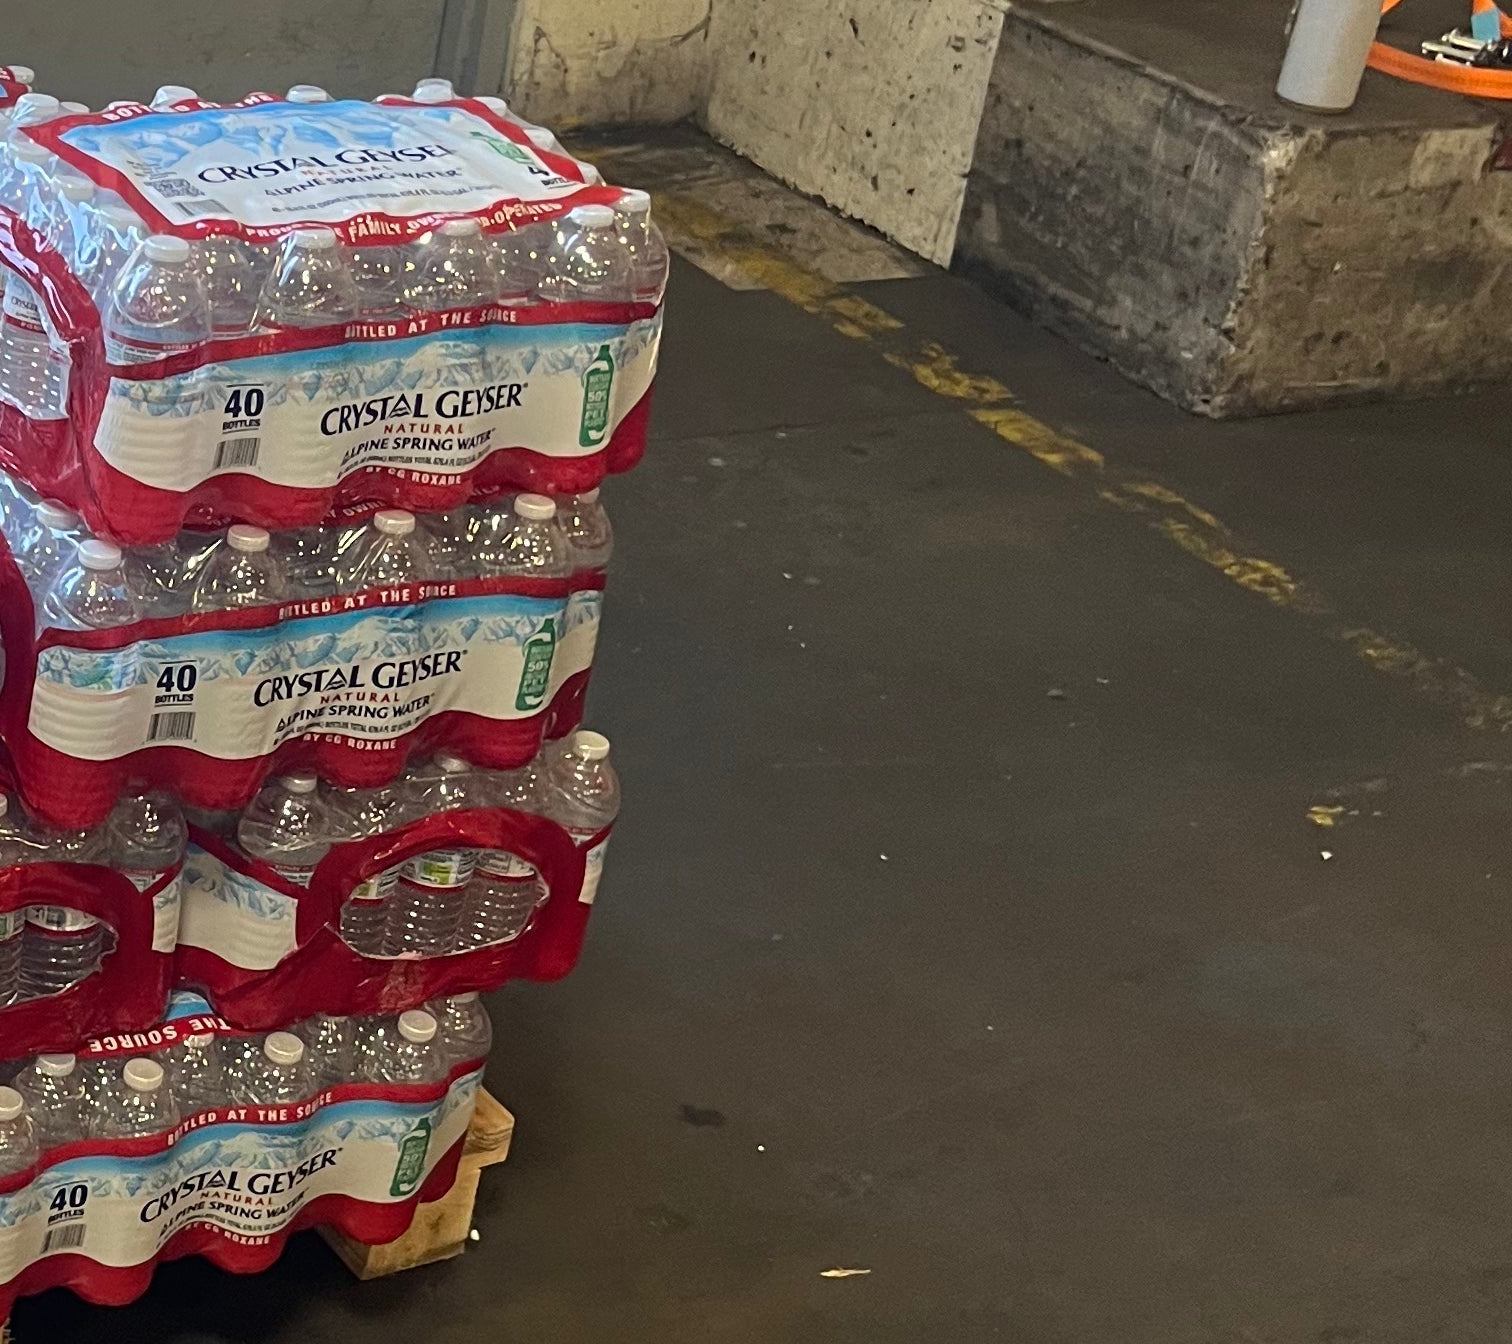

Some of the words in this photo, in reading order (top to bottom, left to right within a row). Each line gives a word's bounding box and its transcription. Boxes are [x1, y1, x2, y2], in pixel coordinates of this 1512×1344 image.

[198, 156, 334, 183] CRYSTAL
[408, 319, 428, 333] AT
[440, 310, 471, 327] THE
[224, 388, 264, 417] 40
[320, 393, 428, 437] CRYSTAL
[434, 382, 522, 418] GEYSER
[222, 419, 261, 430] BOTTLES
[384, 423, 463, 435] NATURAL
[342, 438, 388, 464] ALPINE
[392, 437, 454, 451] SPRING
[457, 429, 491, 450] WATER
[411, 471, 461, 485] ROXANE
[345, 595, 366, 608] AT
[380, 589, 409, 603] THE
[156, 665, 196, 692] 40
[254, 666, 364, 707] CRYSTAL
[372, 650, 462, 689] GEYSER
[155, 693, 193, 703] BOTTLES
[320, 692, 399, 704] NATURAL
[276, 707, 324, 733] ALPINE
[328, 705, 388, 718] SPRING
[393, 695, 430, 717] WATER
[348, 739, 397, 750] ROXANE
[90, 1026, 178, 1053] SOURCE
[227, 1109, 247, 1121] AT
[258, 1108, 287, 1121] THE
[139, 1169, 241, 1223] CRYSTAL
[248, 1148, 337, 1195] GEYSER
[50, 1185, 88, 1211] 40
[200, 1191, 273, 1205] NATURAL
[48, 1209, 85, 1225] BOTTLES
[160, 1201, 205, 1236] ALPINE
[209, 1201, 262, 1219] SPRING
[267, 1191, 305, 1218] WATER
[224, 1231, 270, 1245] ROXANE
